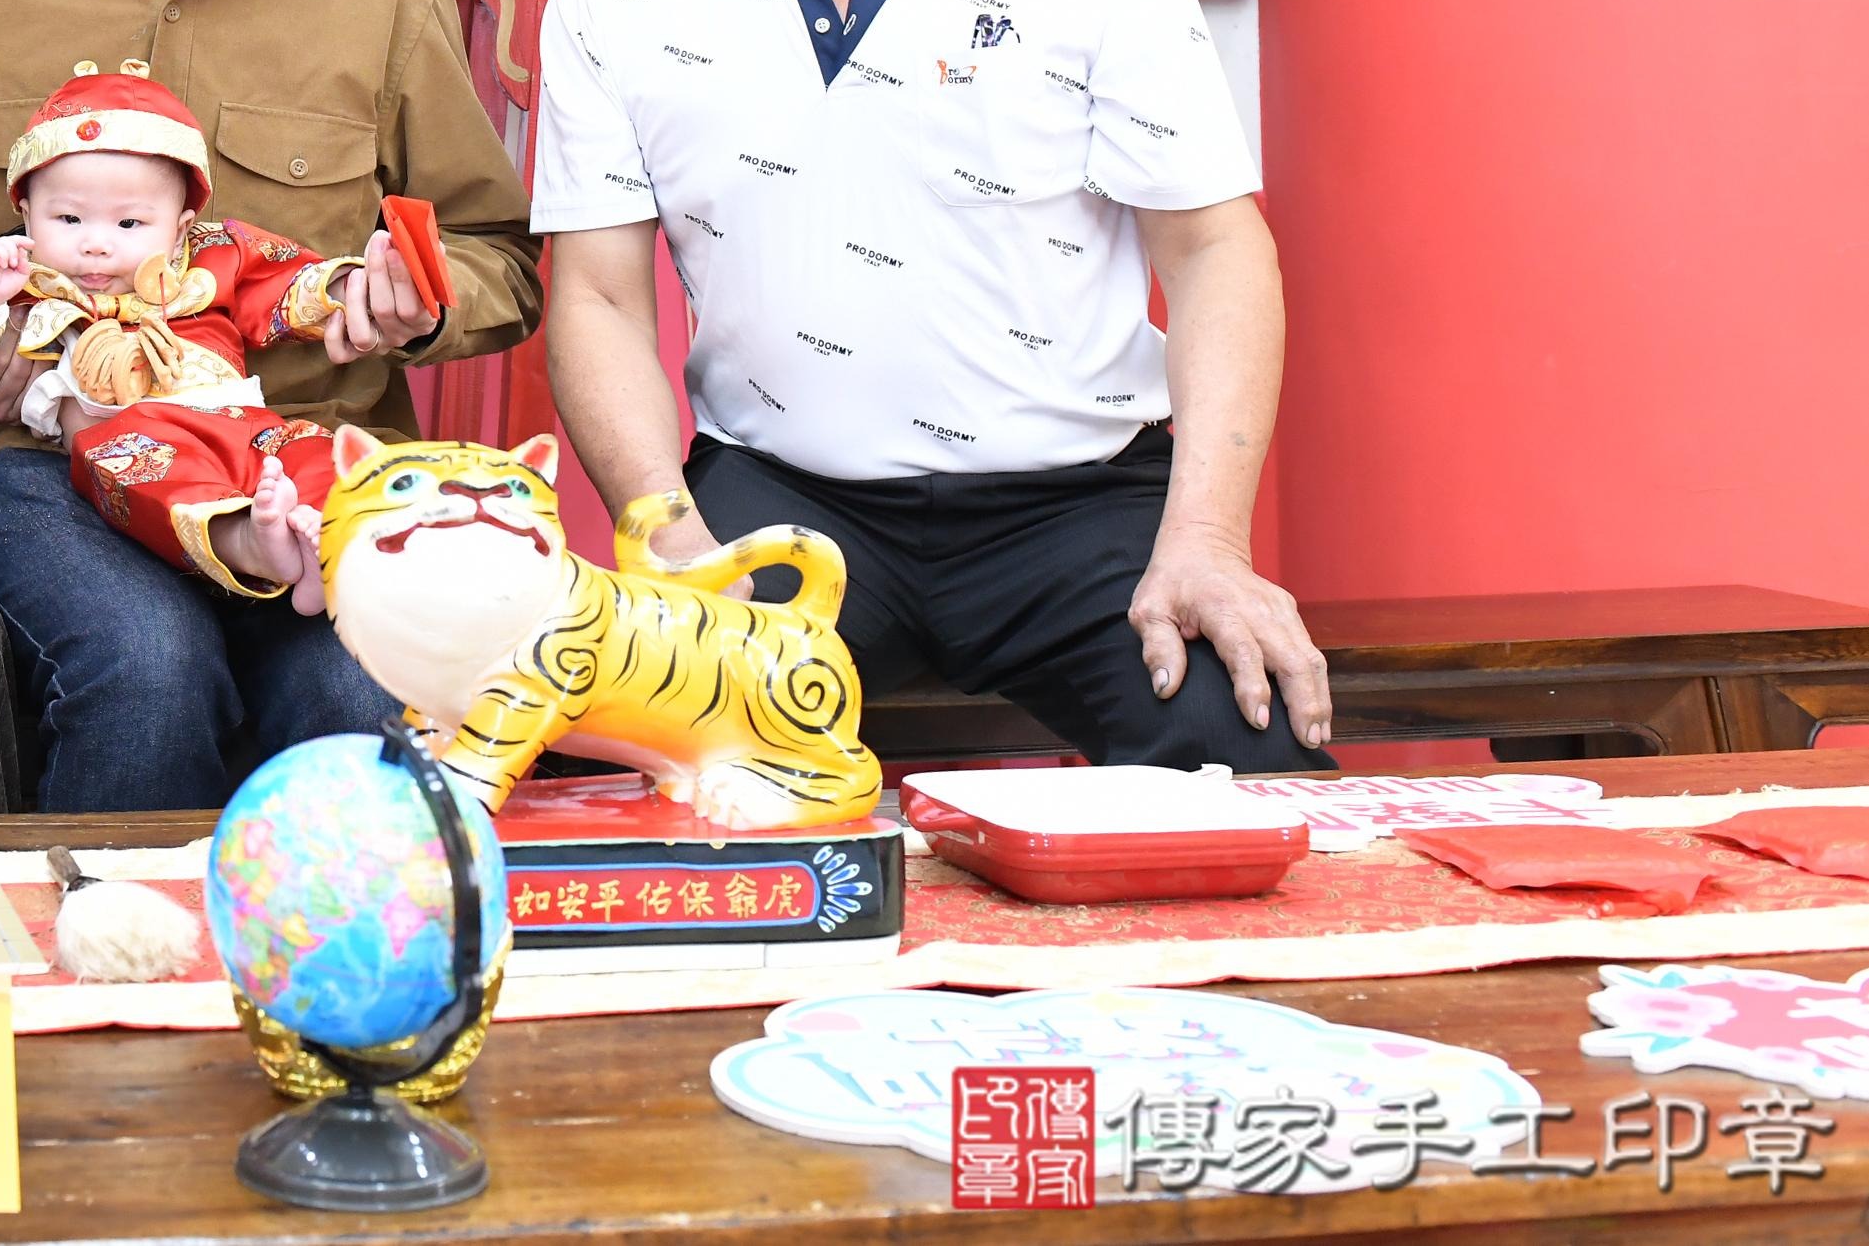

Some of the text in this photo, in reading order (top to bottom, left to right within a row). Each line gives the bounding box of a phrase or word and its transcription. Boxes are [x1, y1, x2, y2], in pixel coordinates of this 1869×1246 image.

[663, 44, 714, 65] PRO DORMY
[844, 58, 905, 88] PRO DORMY
[1045, 70, 1063, 83] PRO
[738, 153, 799, 176] PRO DORMY
[605, 173, 625, 184] PRO
[756, 168, 774, 176] ITALY
[954, 168, 1017, 196] PRO DORMY
[972, 185, 992, 196] ITALY
[684, 213, 702, 225] PRO
[1048, 237, 1084, 255] PRO DORMY
[845, 242, 904, 268] PRO DORMY
[863, 258, 881, 267] ITALY
[1008, 328, 1028, 341] PRO
[796, 331, 853, 357] PRO DORMY
[814, 347, 831, 356] ITALY
[748, 378, 786, 413] PRO DORMY
[1096, 393, 1136, 403] PRO DORMY
[912, 418, 977, 443] PRO DORMY
[933, 433, 952, 443] ITALY
